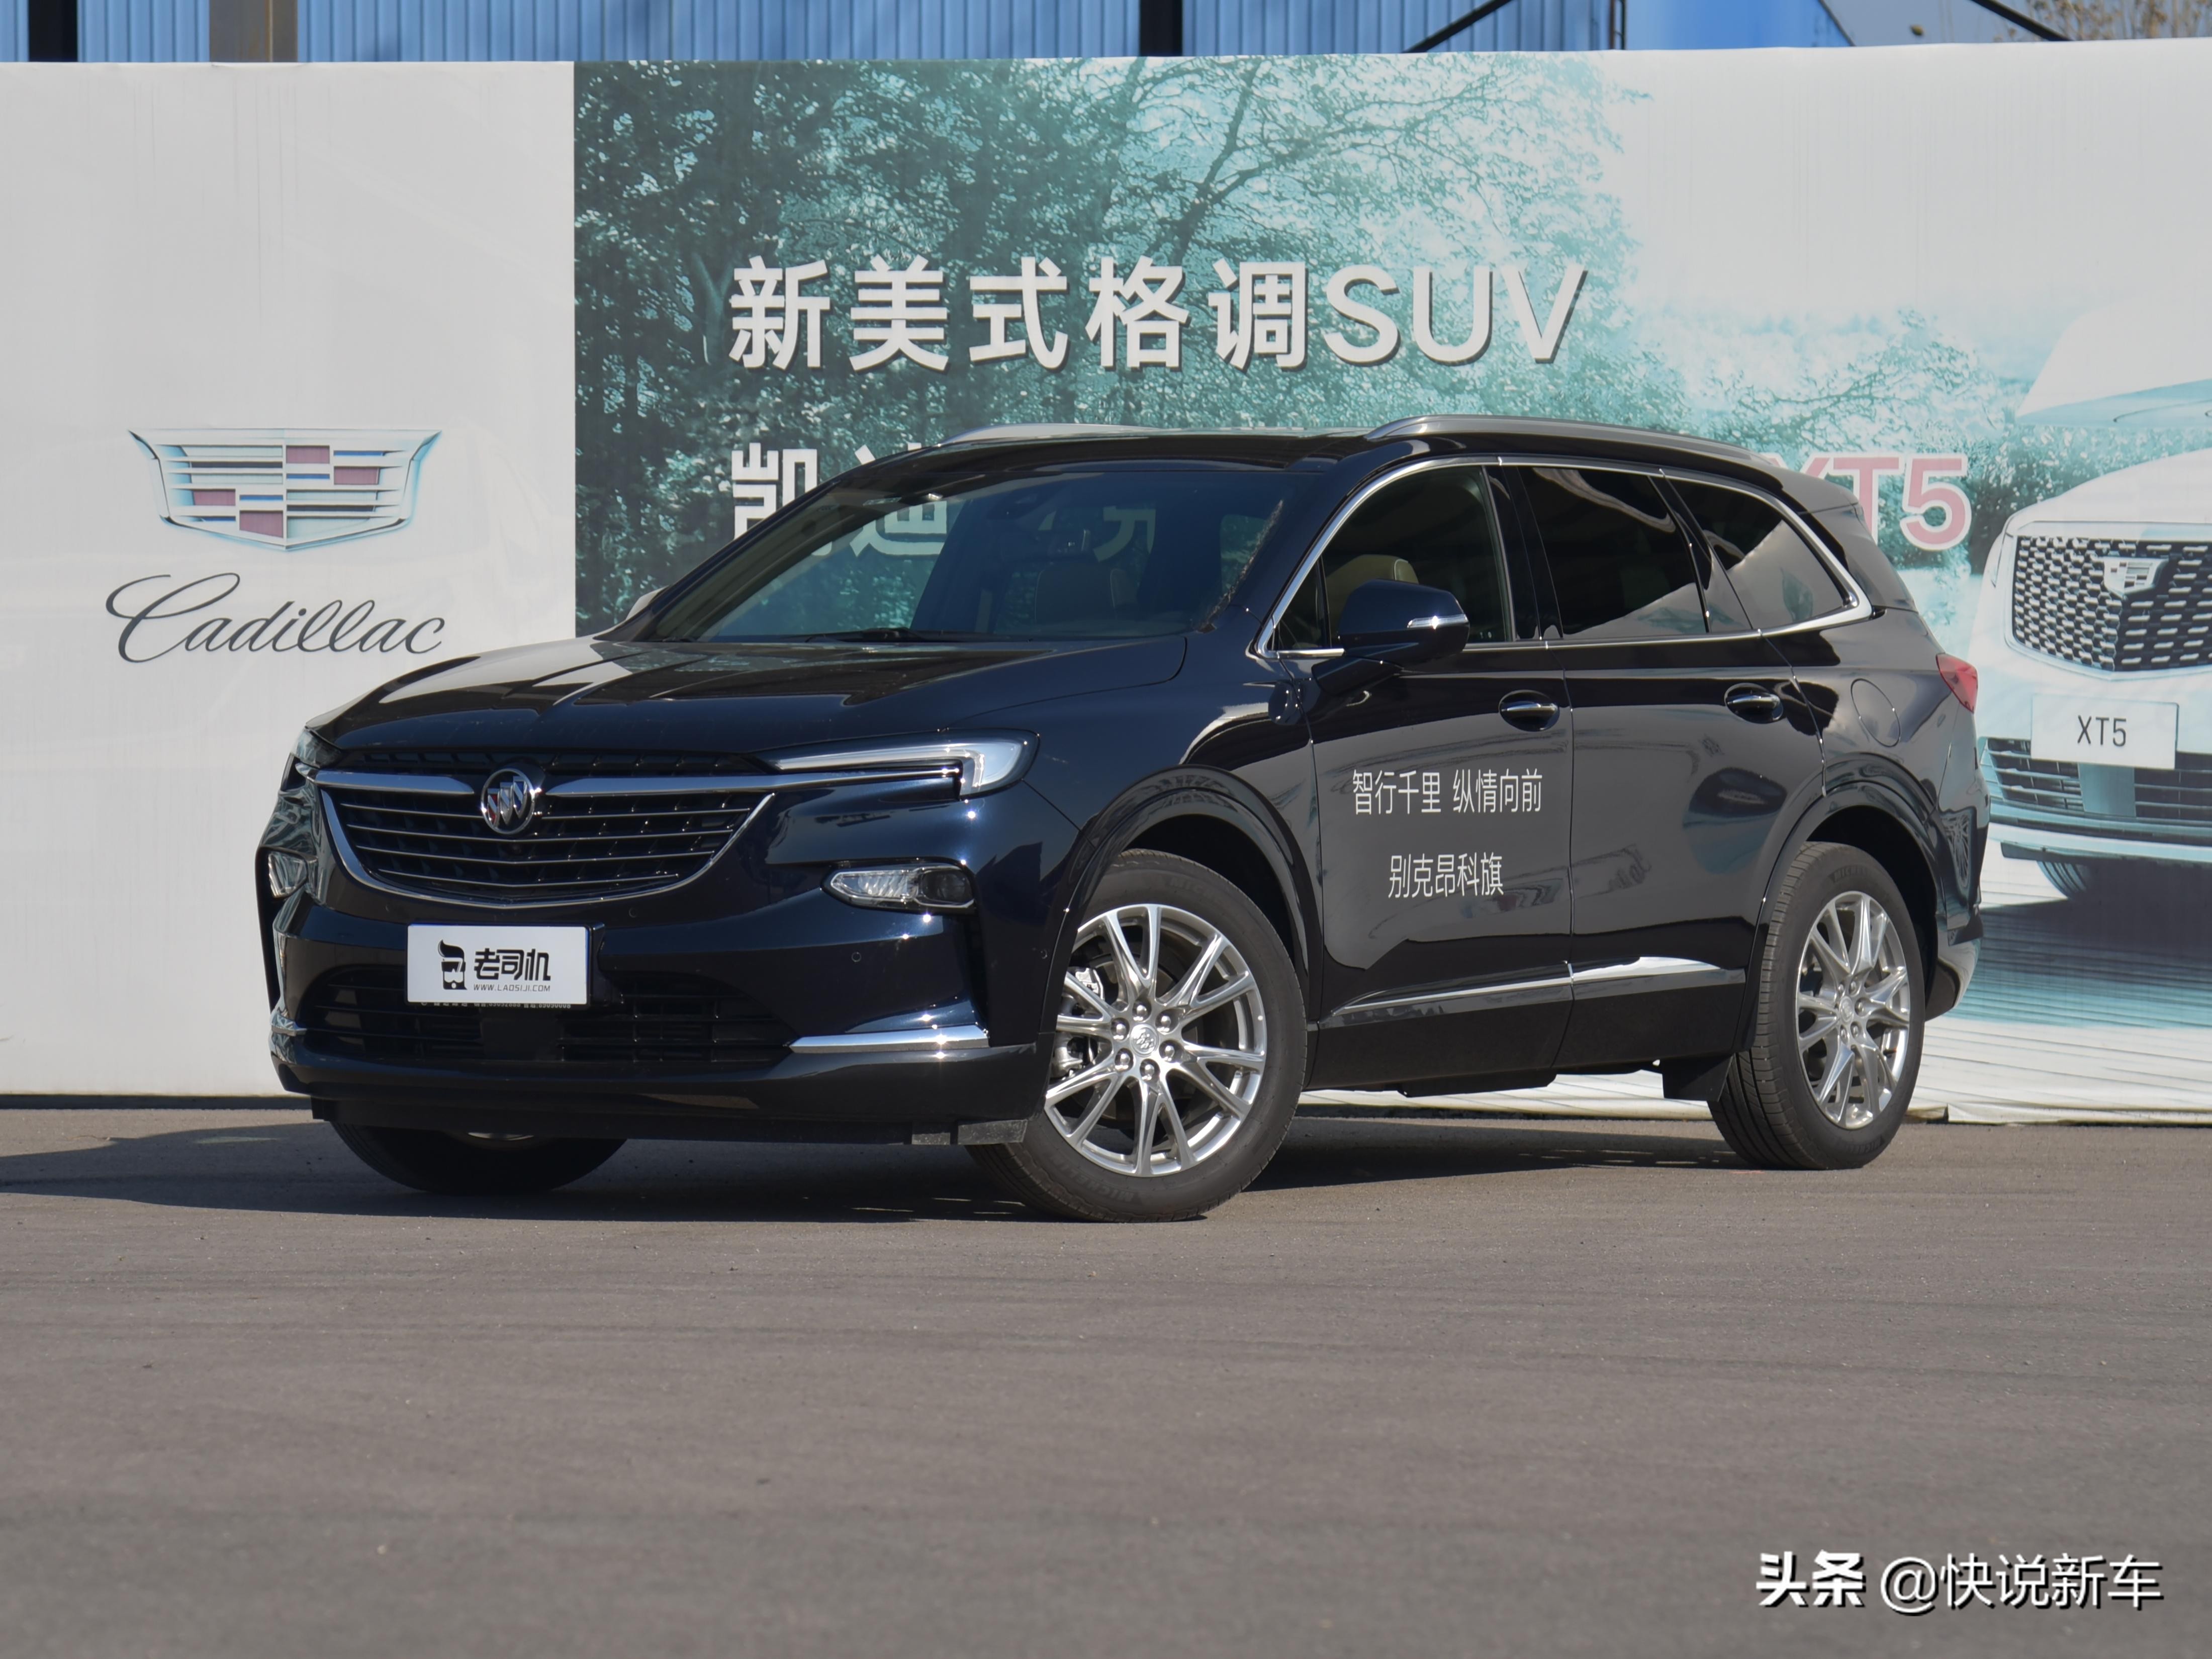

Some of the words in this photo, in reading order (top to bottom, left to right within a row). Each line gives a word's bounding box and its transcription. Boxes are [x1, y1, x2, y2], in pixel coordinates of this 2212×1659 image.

[728, 255, 1587, 371] 新美式格调SUV
[1765, 453, 1972, 550] T5
[105, 572, 445, 663] Cadillac
[2077, 715, 2127, 748] XT5
[1352, 769, 1441, 815] 智行千里
[1452, 768, 1543, 813] 纵情向前
[1388, 852, 1504, 898] 别克昂科旗
[473, 983, 551, 992] WWW.LAOSIJI.COM
[474, 948, 551, 981] 老司机
